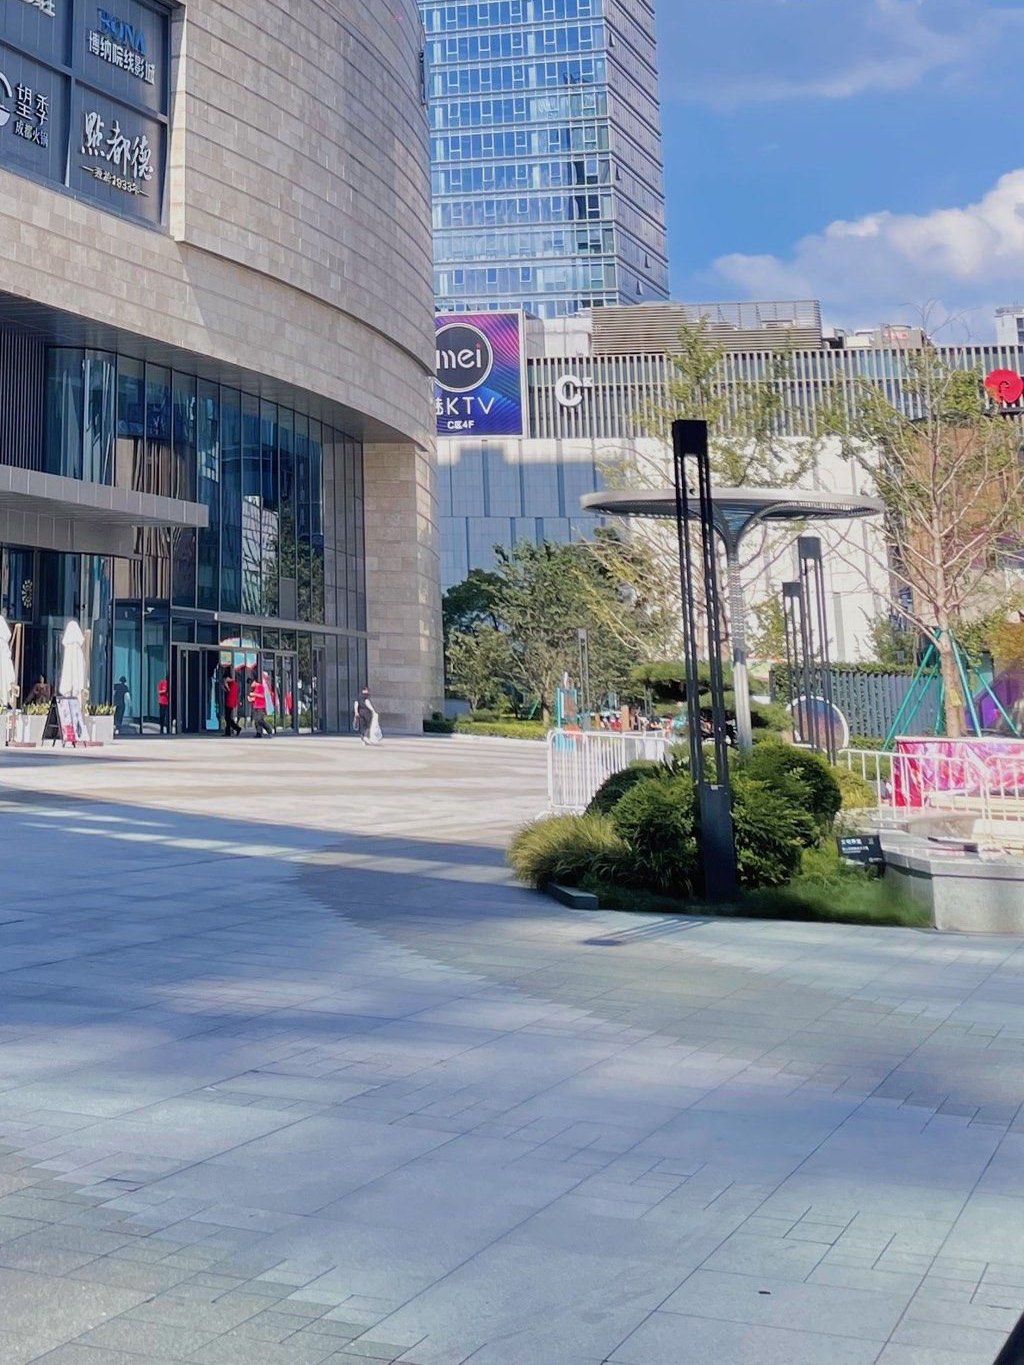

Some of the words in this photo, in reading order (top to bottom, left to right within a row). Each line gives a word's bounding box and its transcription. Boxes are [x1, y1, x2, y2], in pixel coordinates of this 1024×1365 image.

[16, 83, 50, 127] 望季
[14, 119, 49, 148] 成都火锅
